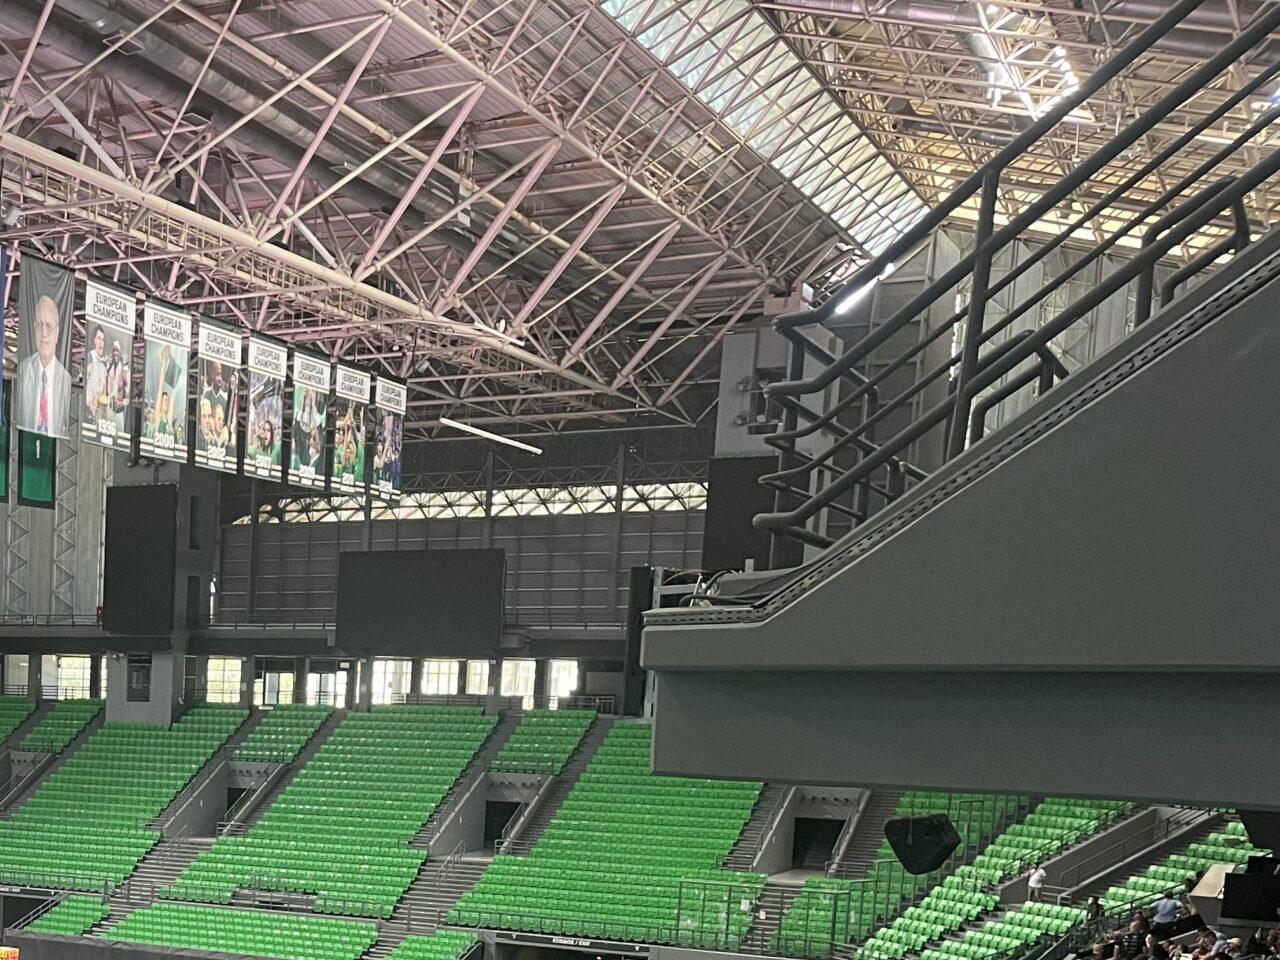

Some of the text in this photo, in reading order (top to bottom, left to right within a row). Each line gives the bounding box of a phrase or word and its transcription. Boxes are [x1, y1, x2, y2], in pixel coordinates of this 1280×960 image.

[96, 292, 128, 314] EUROPEAN
[93, 304, 129, 326] CHAMPIONS
[154, 312, 182, 330] EUROPEAN
[151, 323, 184, 342] CHAMPIONS
[208, 332, 234, 349] EUROPEAN
[206, 342, 236, 360] CHAMPIONS
[256, 346, 281, 362] EUROPEAN
[254, 356, 282, 372] CHAMPIONS
[300, 360, 324, 376] EUROPEAN
[298, 370, 324, 386] CHAMPIONS
[343, 373, 364, 386] EUROPEAN
[341, 382, 364, 396] CHAMPIONS
[98, 418, 116, 436] 1996
[154, 432, 174, 448] 2000
[36, 440, 40, 459] 1
